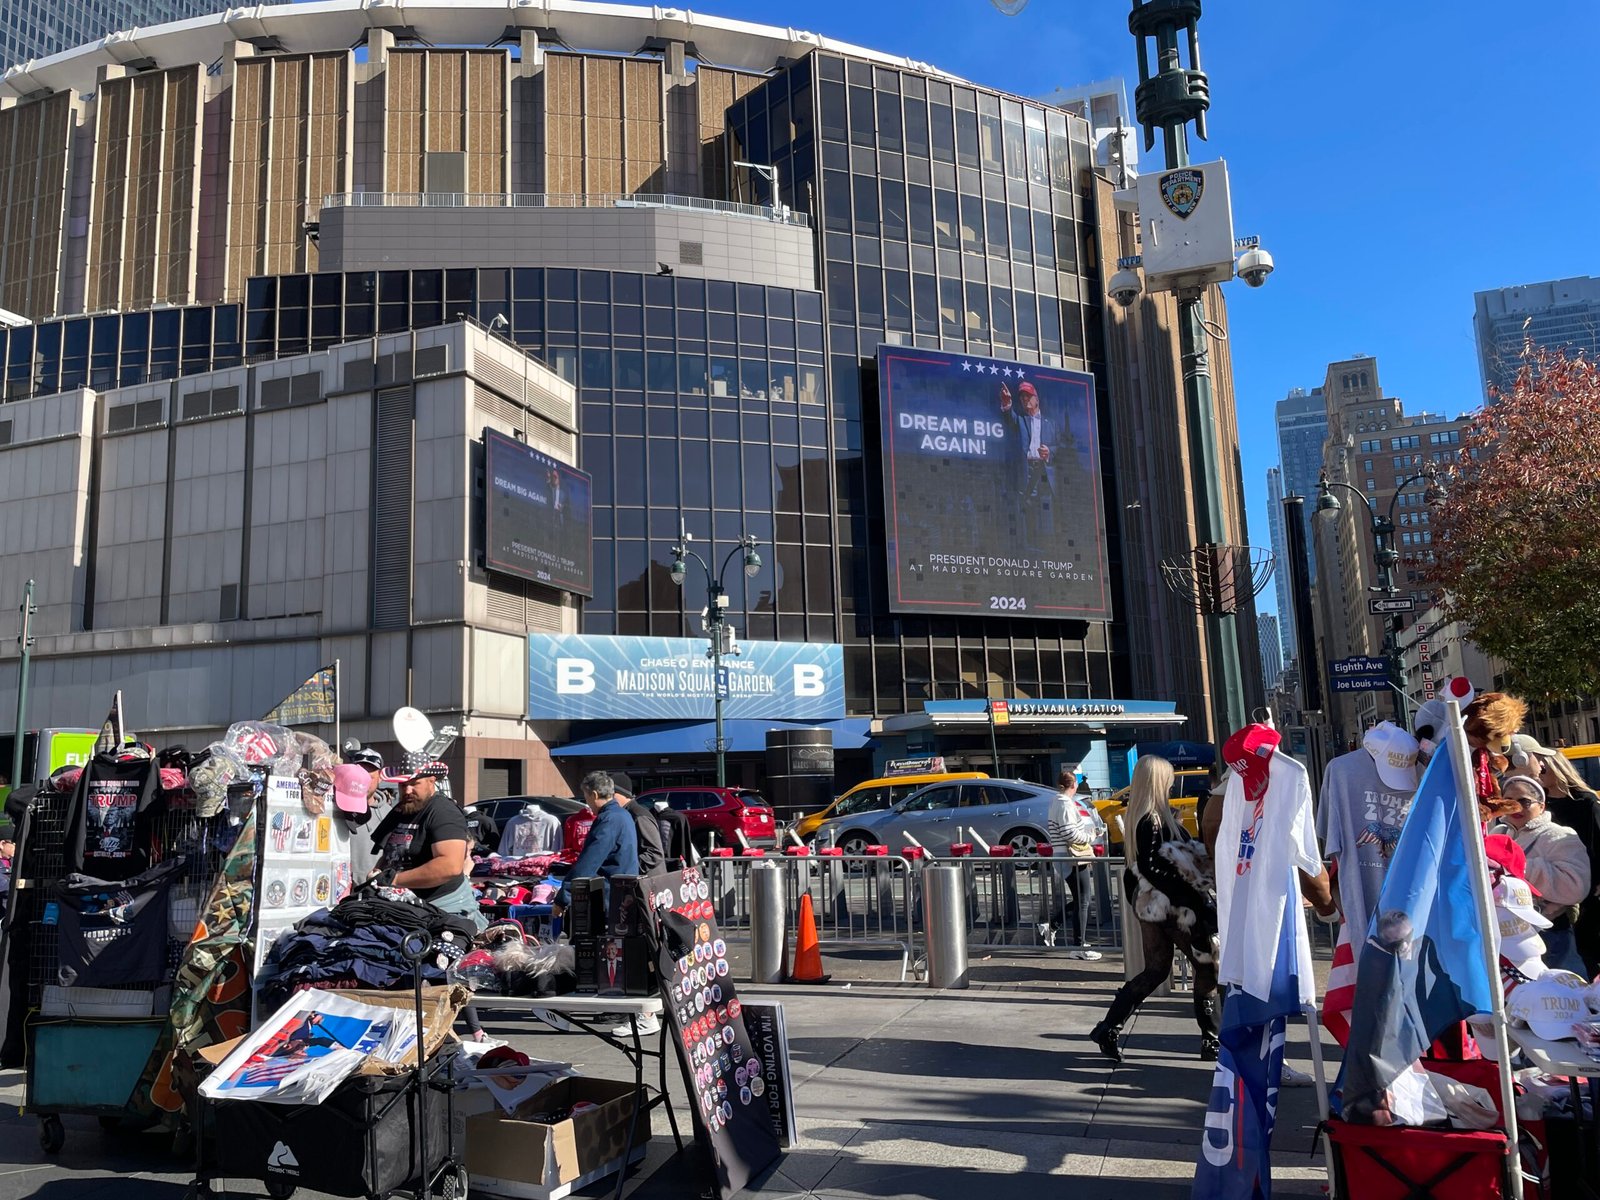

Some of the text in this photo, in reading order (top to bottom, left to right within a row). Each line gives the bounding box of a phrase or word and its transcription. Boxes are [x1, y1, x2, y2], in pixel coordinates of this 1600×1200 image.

[1170, 171, 1193, 180] POLICE
[1162, 176, 1202, 190] DEPARTMENT
[1235, 235, 1258, 247] NYPD
[1119, 255, 1141, 267] NYPD
[900, 413, 1004, 438] DREAM BIG
[921, 434, 986, 455] AGAIN!
[494, 476, 547, 505] DREAM BIG AGAIN!
[512, 541, 537, 556] PRESIDENT
[537, 549, 556, 562] DONALD
[930, 553, 1073, 571] PRESIDENT DONALD J. TRUMP
[537, 570, 551, 581] 2024
[909, 564, 1093, 581] AT MADISON SQUARE GARDEN
[990, 596, 1027, 610] 2024
[640, 658, 677, 668] CHASE
[1334, 662, 1383, 673] Eighth Ave
[556, 657, 595, 694] B
[617, 670, 675, 691] MADISON
[679, 670, 715, 692] SQUAR
[793, 664, 825, 697] B
[1337, 681, 1350, 689] Joe
[1351, 679, 1371, 688] Louis
[1082, 704, 1125, 713] STATION
[1178, 744, 1187, 755] A
[89, 793, 137, 808] TRUMP
[289, 791, 300, 799] FOR
[112, 928, 132, 936] 2024
[1541, 997, 1580, 1012] TRUMP
[1554, 1011, 1574, 1020] 2024
[761, 1015, 772, 1032] I'M
[763, 1035, 777, 1081] VOTING
[767, 1084, 779, 1109] FOR
